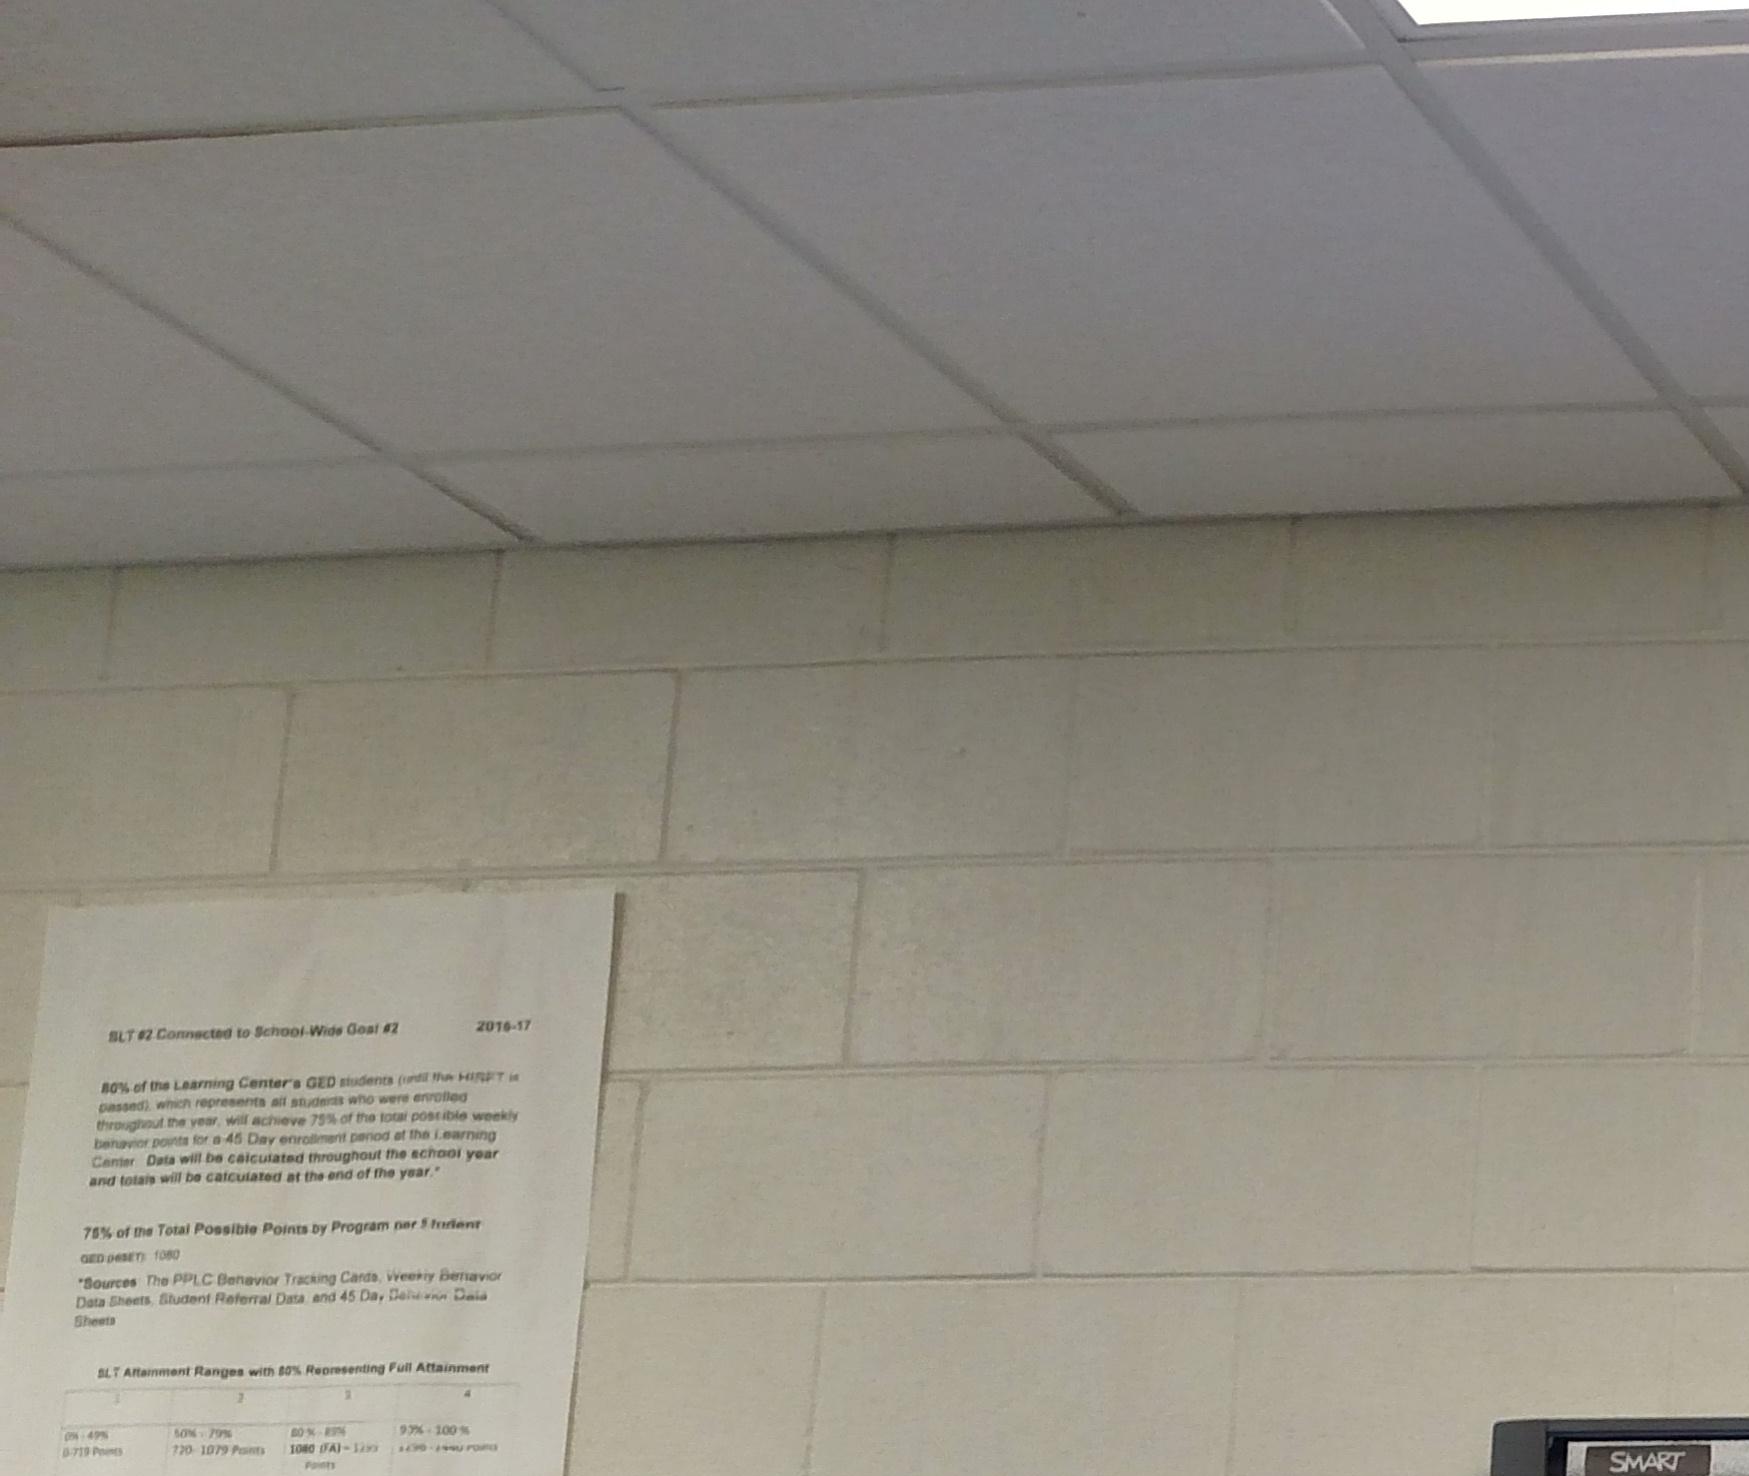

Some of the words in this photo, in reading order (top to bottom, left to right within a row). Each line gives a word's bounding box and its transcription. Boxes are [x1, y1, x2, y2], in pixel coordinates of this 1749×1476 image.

[156, 1028, 233, 1041] Connected
[237, 1029, 249, 1039] to
[347, 1023, 378, 1035] Goal
[382, 1022, 399, 1034] #2
[476, 1020, 531, 1033] 2016-17
[133, 1081, 147, 1093] of
[150, 1080, 170, 1091] the
[174, 1078, 235, 1092] Learning
[306, 1076, 336, 1089] GED
[356, 1112, 376, 1123] the
[147, 1154, 175, 1167] Data
[180, 1153, 201, 1164] will
[206, 1152, 223, 1164] be
[227, 1152, 304, 1164] calculated
[308, 1149, 381, 1164] throughout
[386, 1149, 407, 1160] the
[411, 1148, 461, 1159] school
[466, 1149, 499, 1162] year
[89, 1175, 115, 1186] and
[160, 1172, 182, 1183] will
[186, 1172, 201, 1183] be
[206, 1170, 282, 1183] calculated
[287, 1170, 300, 1183] at
[304, 1171, 324, 1182] the
[328, 1167, 352, 1180] end
[356, 1167, 371, 1180] of
[374, 1166, 395, 1179] the
[117, 1226, 131, 1239] of
[134, 1225, 153, 1238] the
[158, 1223, 190, 1236] Total
[194, 1222, 258, 1236] Possible
[262, 1222, 308, 1236] Points
[312, 1222, 327, 1237] by
[331, 1219, 390, 1234] Program
[194, 1365, 244, 1379] Ranges
[249, 1366, 275, 1377] with
[389, 1362, 412, 1373] Full
[416, 1362, 490, 1374] Attainment
[1609, 1450, 1687, 1473] SMART
